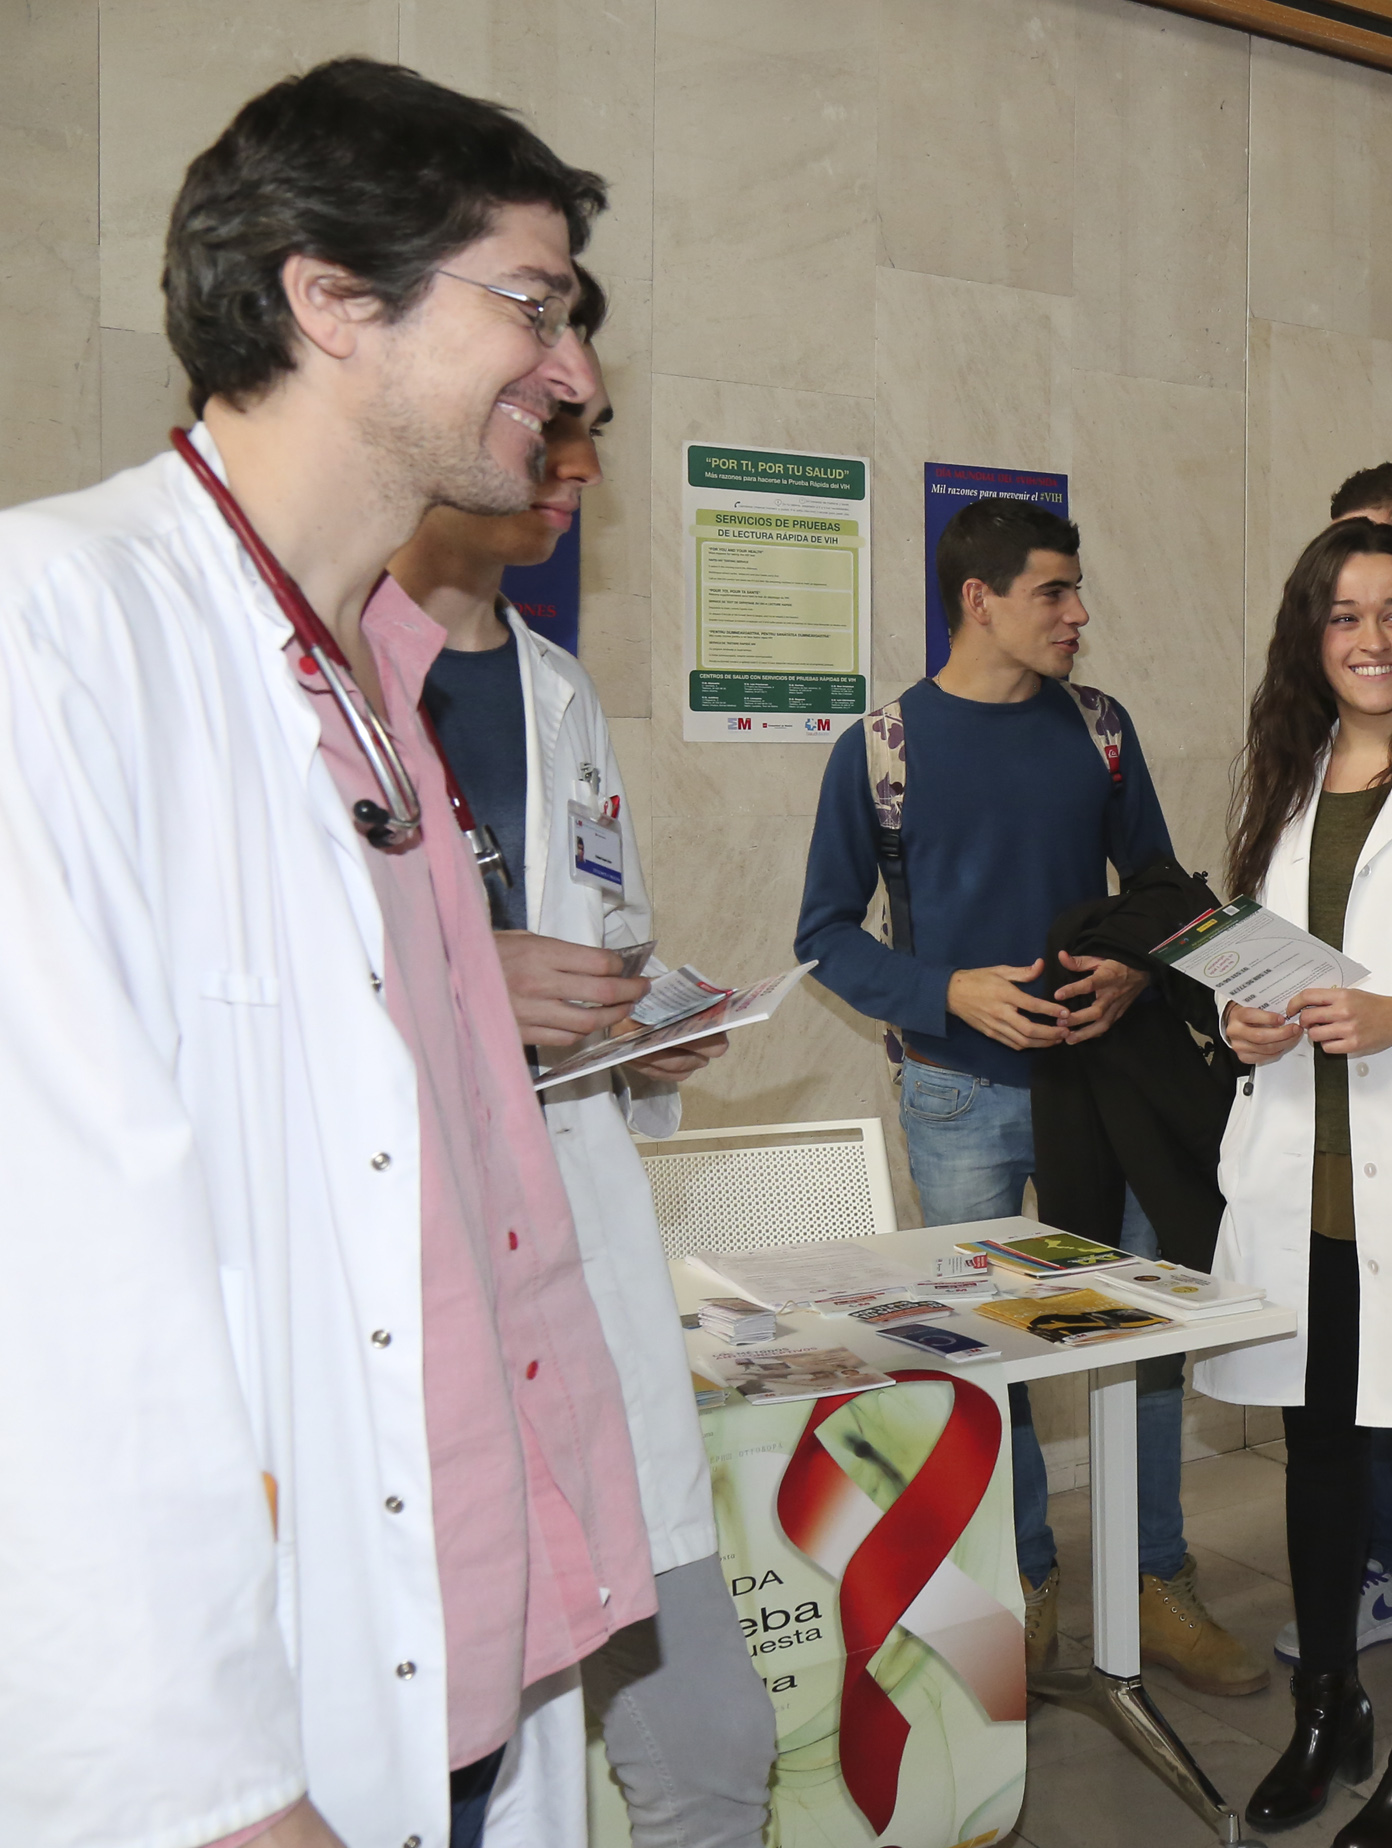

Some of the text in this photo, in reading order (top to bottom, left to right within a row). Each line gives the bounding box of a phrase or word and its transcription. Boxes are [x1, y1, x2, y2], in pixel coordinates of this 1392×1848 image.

[706, 457, 850, 480] “POR TI, POR TU SALUD”
[954, 469, 995, 482] MUNDIAL
[704, 471, 718, 479] Más
[758, 476, 780, 484] hacerse
[788, 478, 808, 487] Prueba
[810, 480, 830, 489] Rápida
[931, 484, 946, 494] Mil
[948, 486, 978, 497] razones
[979, 490, 997, 500] para
[999, 491, 1030, 501] prevenir
[1031, 492, 1038, 501] el
[715, 514, 841, 532] SERVICIOS DE PRUEBAS
[718, 528, 838, 545] DE LECTURA RÁPIDA DE VIH
[731, 1569, 784, 1597] DA
[738, 1600, 823, 1638] eba
[762, 1674, 798, 1693] a
